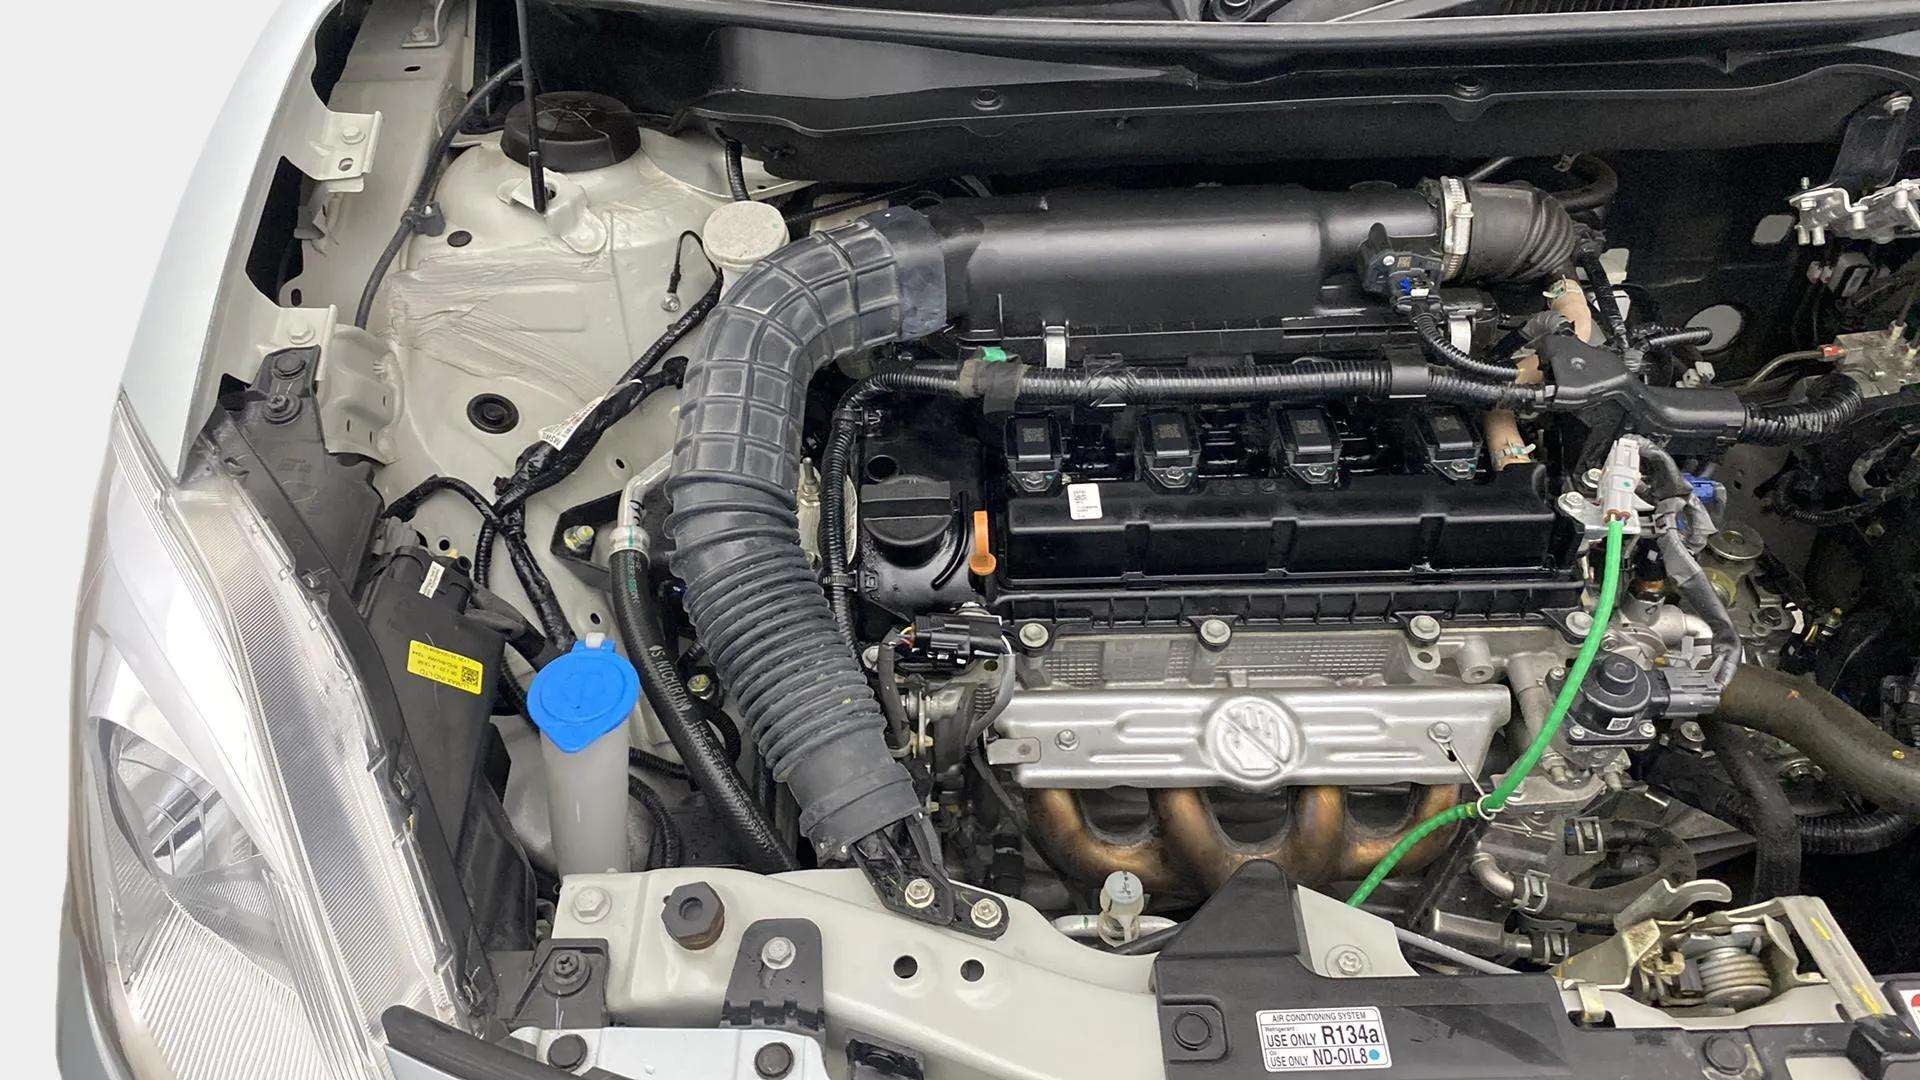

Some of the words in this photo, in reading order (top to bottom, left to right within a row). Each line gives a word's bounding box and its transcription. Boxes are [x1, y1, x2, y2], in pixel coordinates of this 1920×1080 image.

[656, 659, 690, 709] NICHIRIN
[1272, 1014, 1283, 1022] AIR
[1286, 1012, 1336, 1022] CONDITIONING
[1338, 1011, 1366, 1020] SYSTEM
[1266, 1034, 1288, 1047] USE
[1290, 1033, 1316, 1046] ONLY
[1321, 1024, 1380, 1045] R134a
[1270, 1056, 1287, 1067] USE
[1289, 1056, 1308, 1066] ONLY
[1313, 1048, 1368, 1065] ND-OIL8
